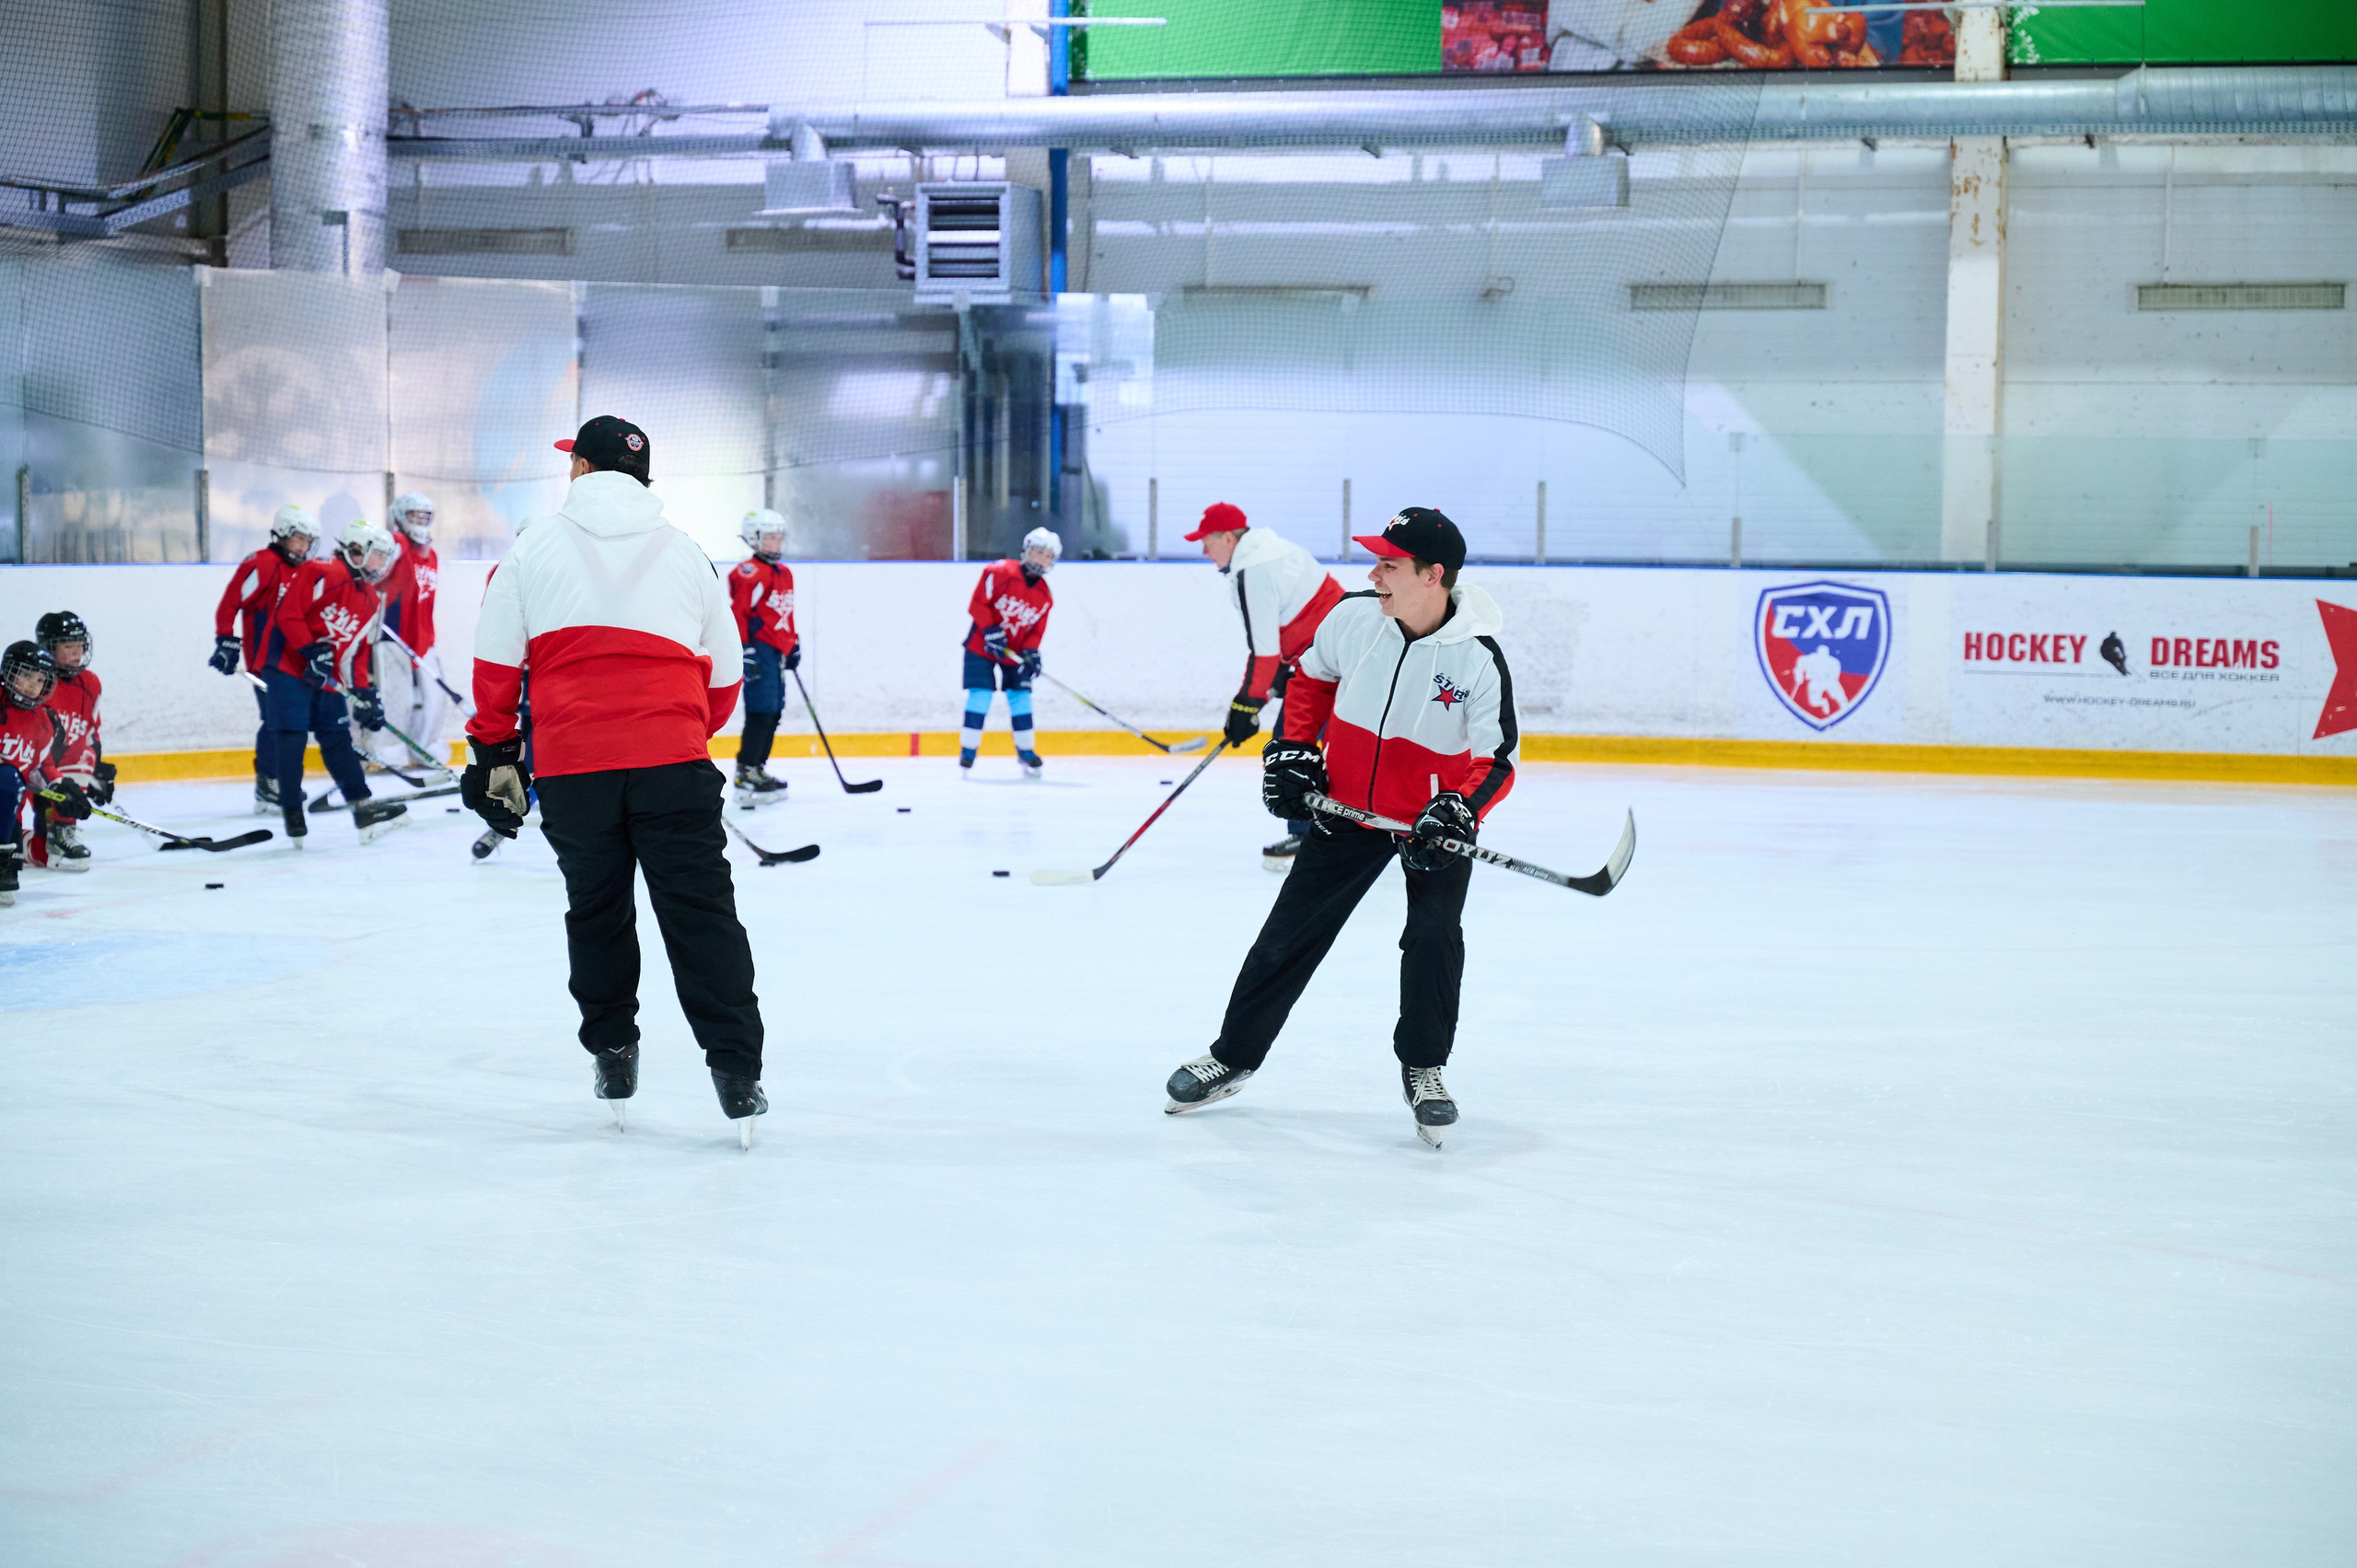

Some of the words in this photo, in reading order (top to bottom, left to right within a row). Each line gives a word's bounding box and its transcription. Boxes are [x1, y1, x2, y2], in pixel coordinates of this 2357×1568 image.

[1771, 604, 1875, 640] СХЛ
[1964, 631, 2088, 664] HOCKEY
[2150, 636, 2281, 670] DREAMS
[2150, 669, 2179, 680] ВСЕ
[2182, 670, 2214, 681] ДЛЯ
[2218, 671, 2280, 683] ХОККЕЯ
[1265, 750, 1320, 767] CCM
